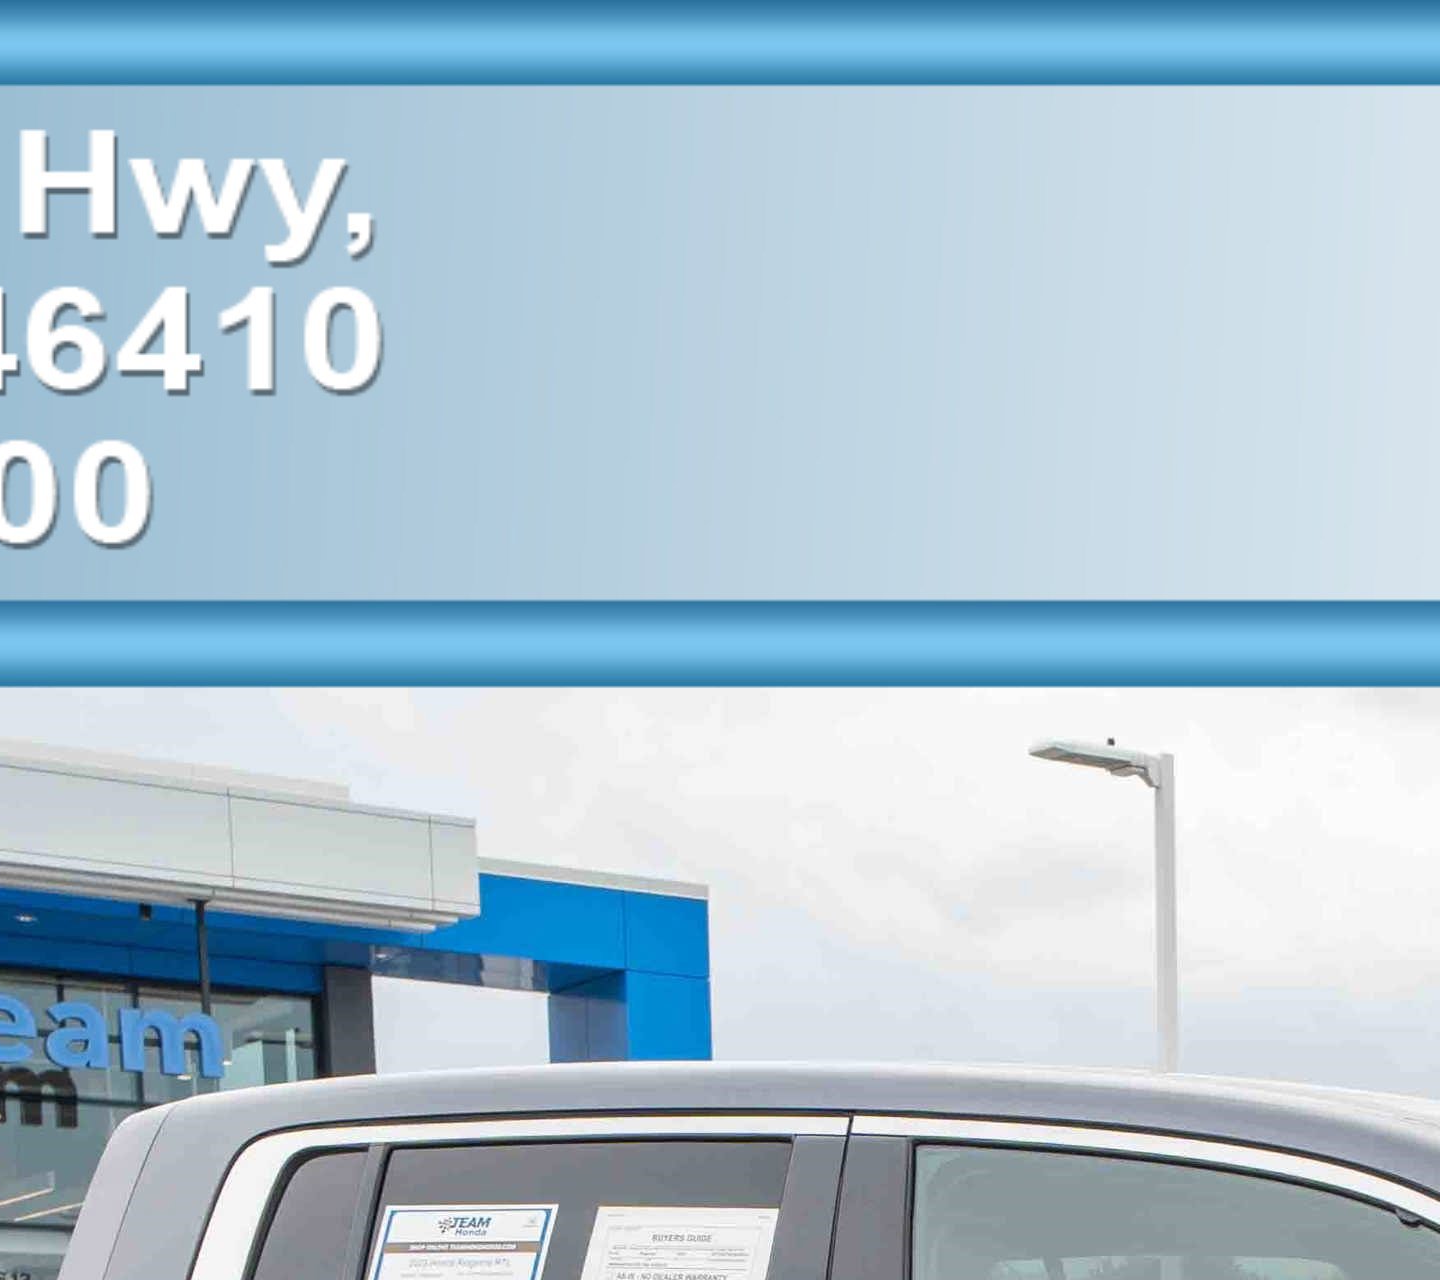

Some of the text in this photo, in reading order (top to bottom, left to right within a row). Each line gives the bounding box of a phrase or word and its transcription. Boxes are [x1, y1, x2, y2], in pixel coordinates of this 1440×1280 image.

[452, 1217, 492, 1228] TEAM
[455, 1228, 488, 1236] Honda
[651, 1233, 713, 1243] BUYERS GUIDE
[641, 1273, 651, 1280] NO
[652, 1273, 684, 1280] DEALER
